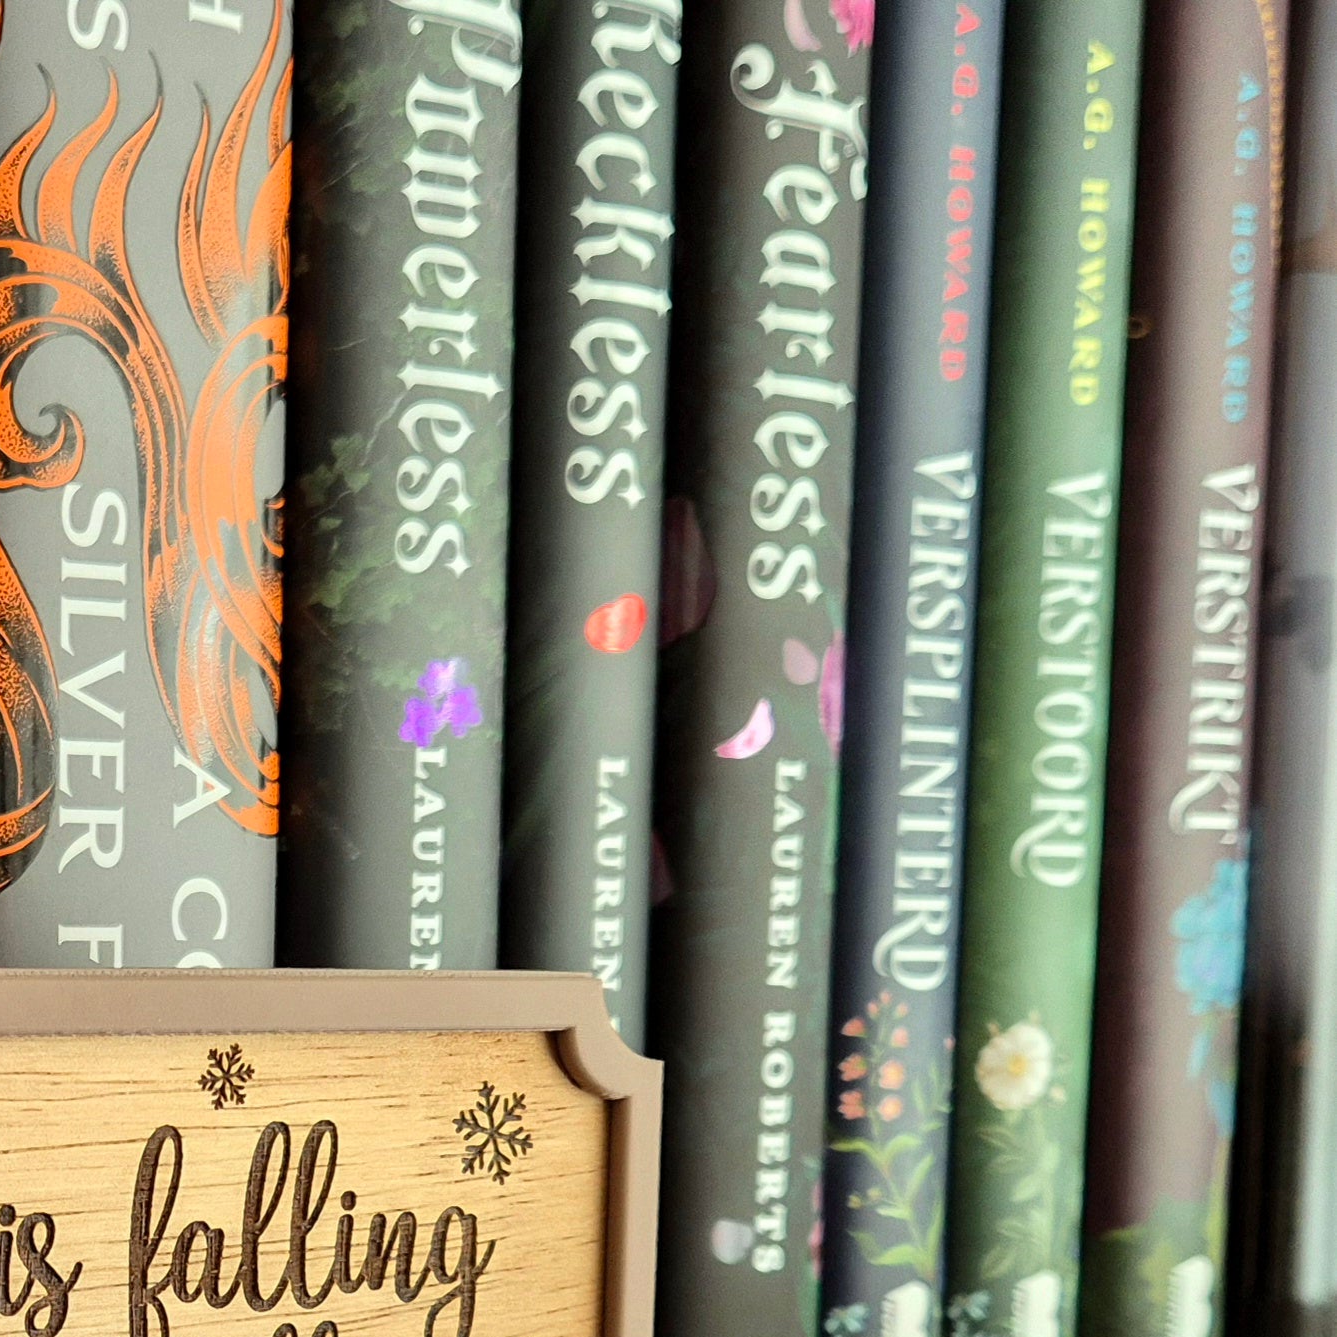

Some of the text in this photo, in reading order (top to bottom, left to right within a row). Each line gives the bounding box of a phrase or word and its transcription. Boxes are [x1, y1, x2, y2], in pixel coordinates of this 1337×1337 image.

[730, 42, 868, 606] Fearless
[938, 144, 977, 382] HOWARD
[1068, 177, 1110, 407] HOWARD
[1220, 202, 1259, 424] HOWARD
[57, 481, 128, 874] SILVER
[172, 744, 233, 829] A
[872, 450, 977, 992] VERSPLINTERD
[1010, 470, 1112, 888] VERSTOORD
[1168, 462, 1260, 845] VERSTRIKT
[751, 757, 809, 1274] LAUREN ROBERTS
